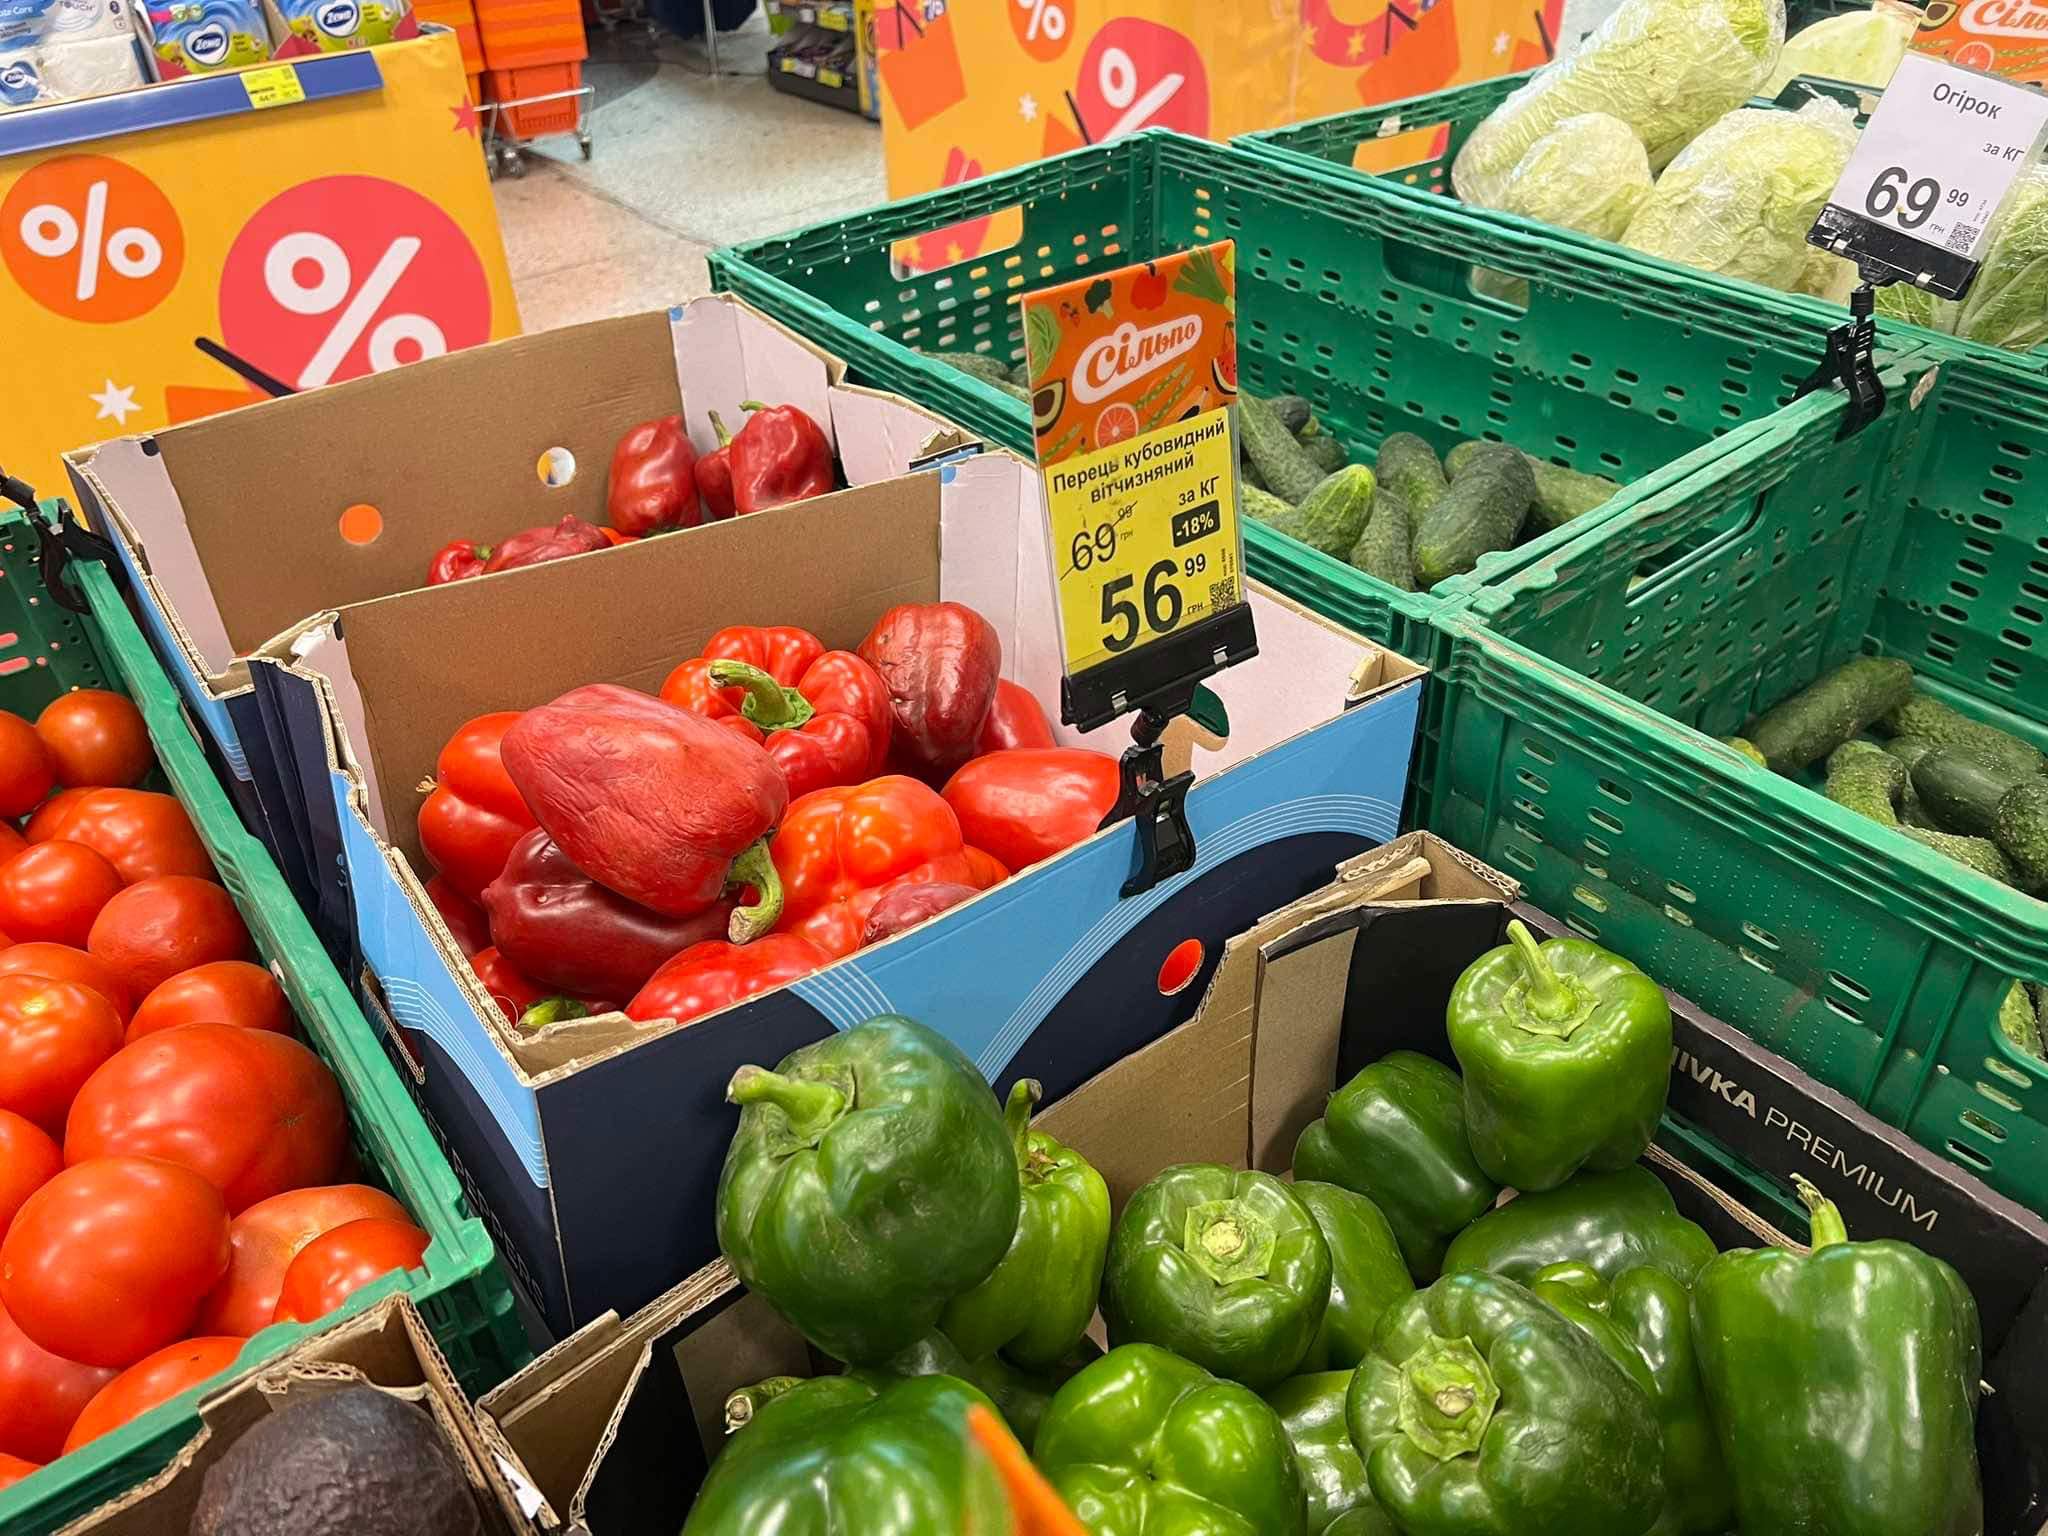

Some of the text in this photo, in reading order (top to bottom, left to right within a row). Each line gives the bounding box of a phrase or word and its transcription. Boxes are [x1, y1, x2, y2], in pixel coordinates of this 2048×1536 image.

[1933, 83, 2002, 119] Огірок
[1983, 142, 2025, 163] за КГ
[1865, 166, 1941, 229] 69
[1946, 189, 1969, 207] 99
[1085, 321, 1196, 389] Сільпо
[1053, 418, 1225, 494] Перець кубовидний
[1091, 450, 1194, 503] вітчизняний
[1178, 475, 1220, 506] за КГ
[1071, 504, 1133, 571] 69 99
[1175, 511, 1214, 538] -18%
[1100, 559, 1182, 653] 56
[1184, 553, 1206, 577] 99
[1764, 1106, 1939, 1231] PREMIUM
